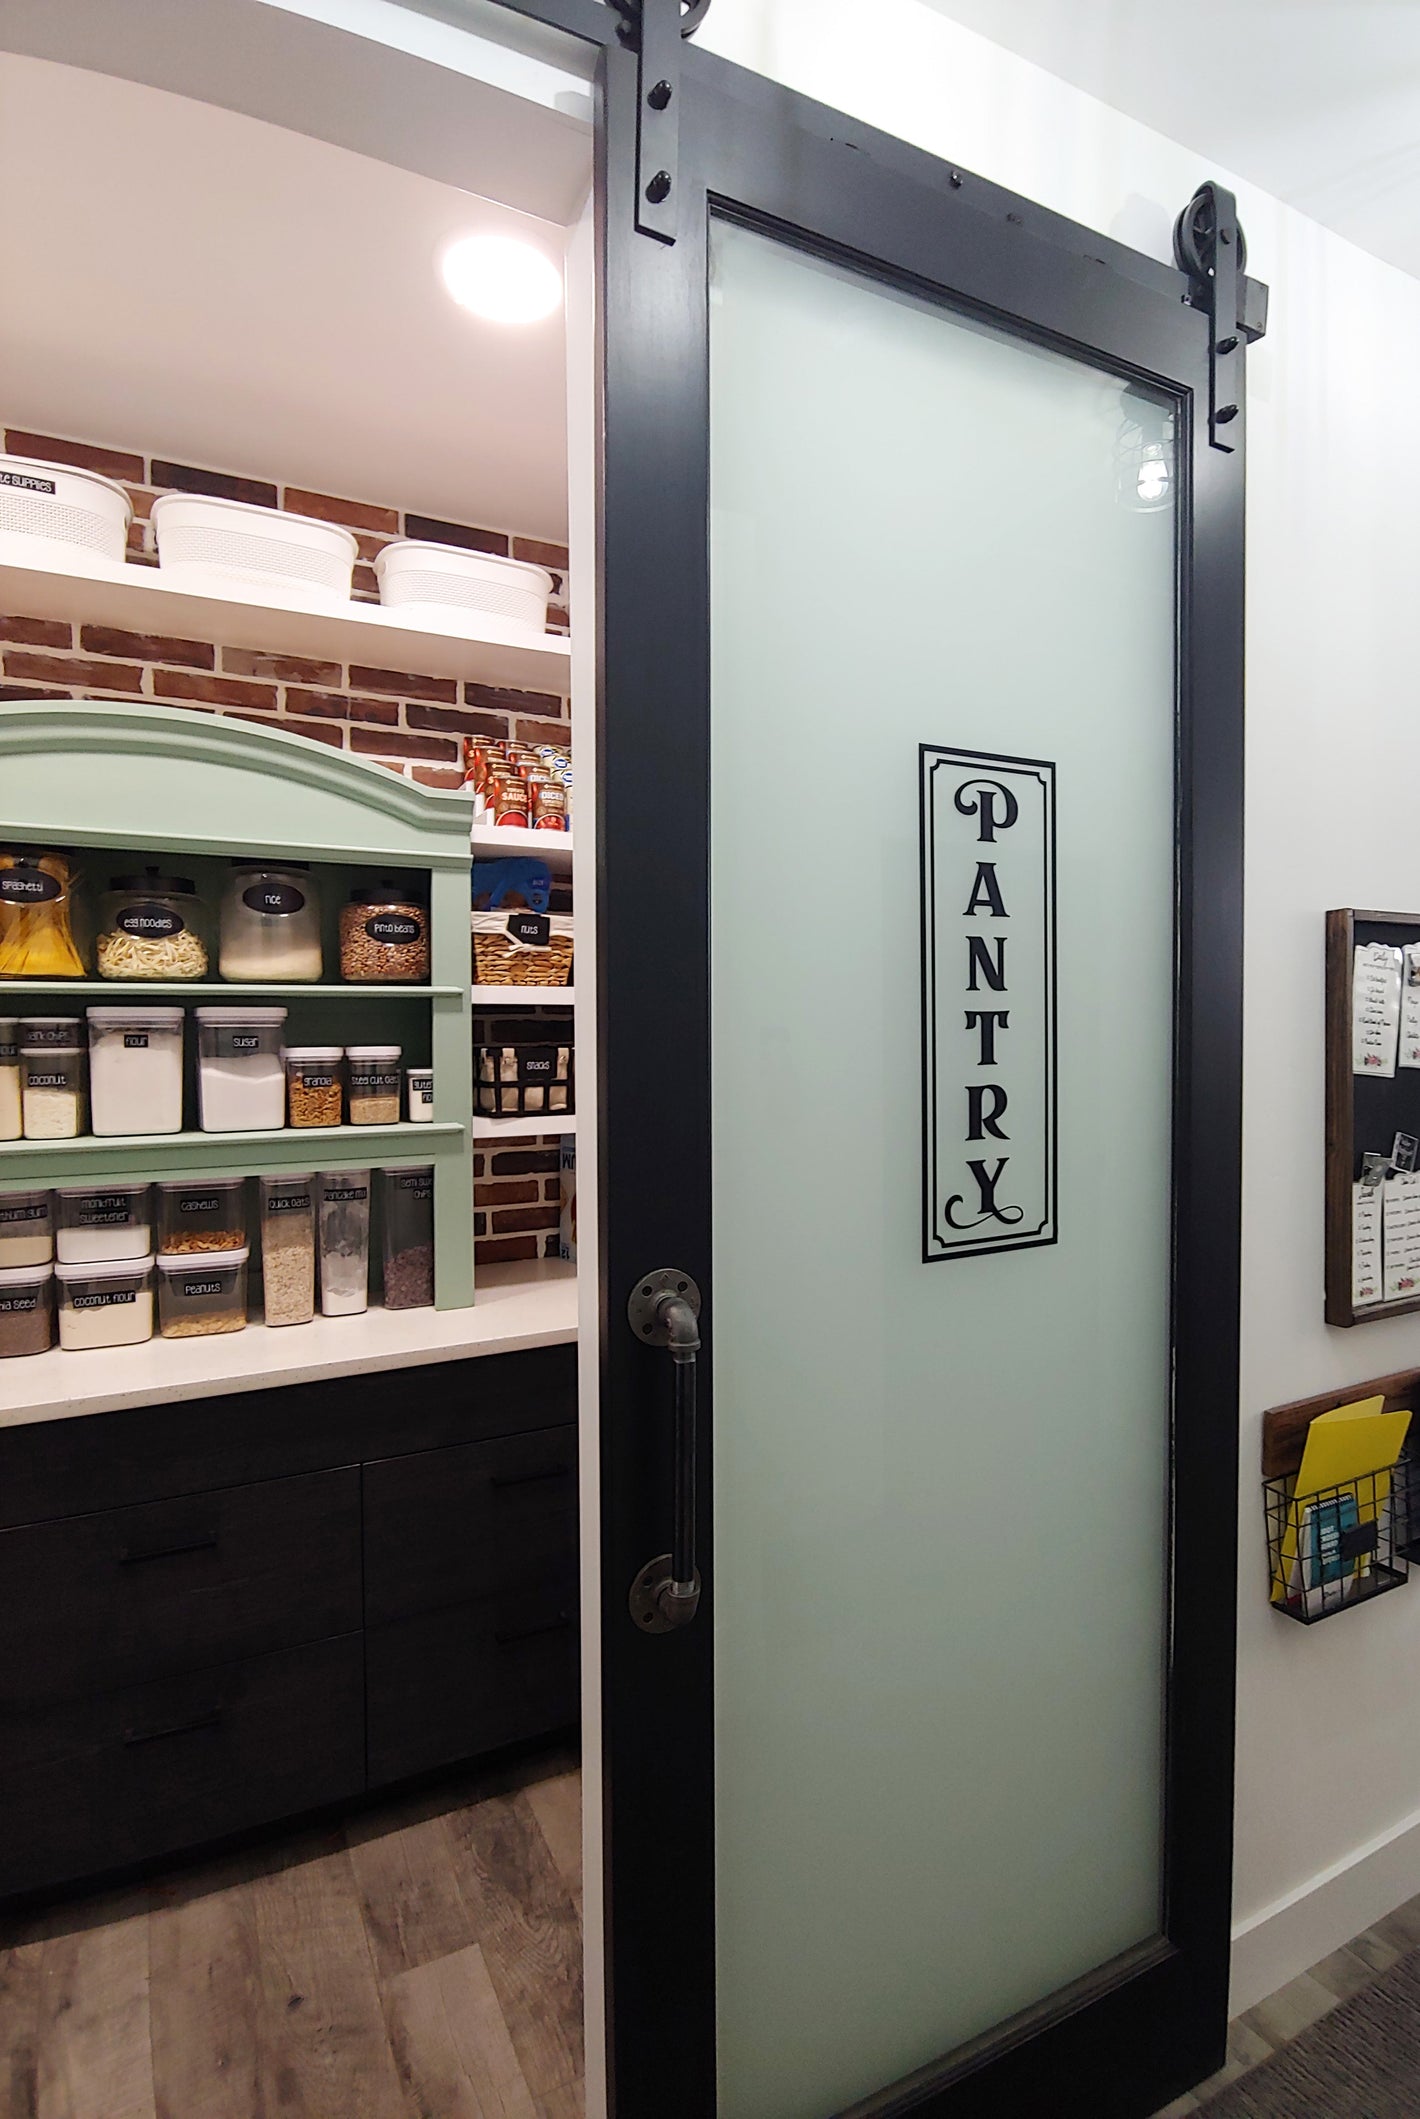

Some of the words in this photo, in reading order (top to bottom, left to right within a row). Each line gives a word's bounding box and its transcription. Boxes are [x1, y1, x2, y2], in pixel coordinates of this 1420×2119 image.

[501, 792, 528, 803] SAUCE
[1, 880, 44, 893] spaghetti
[264, 894, 281, 905] rice
[123, 918, 139, 928] egg
[140, 918, 173, 929] noodles
[394, 923, 415, 934] beans
[520, 925, 539, 935] nuts
[944, 778, 1024, 1230] PANTRY
[125, 1036, 148, 1046] flour
[233, 1037, 258, 1047] sugar
[28, 1075, 66, 1086] coconut
[303, 1076, 332, 1087] granola
[13, 1299, 37, 1311] seed
[73, 1295, 111, 1308] coconut
[113, 1292, 136, 1303] flour
